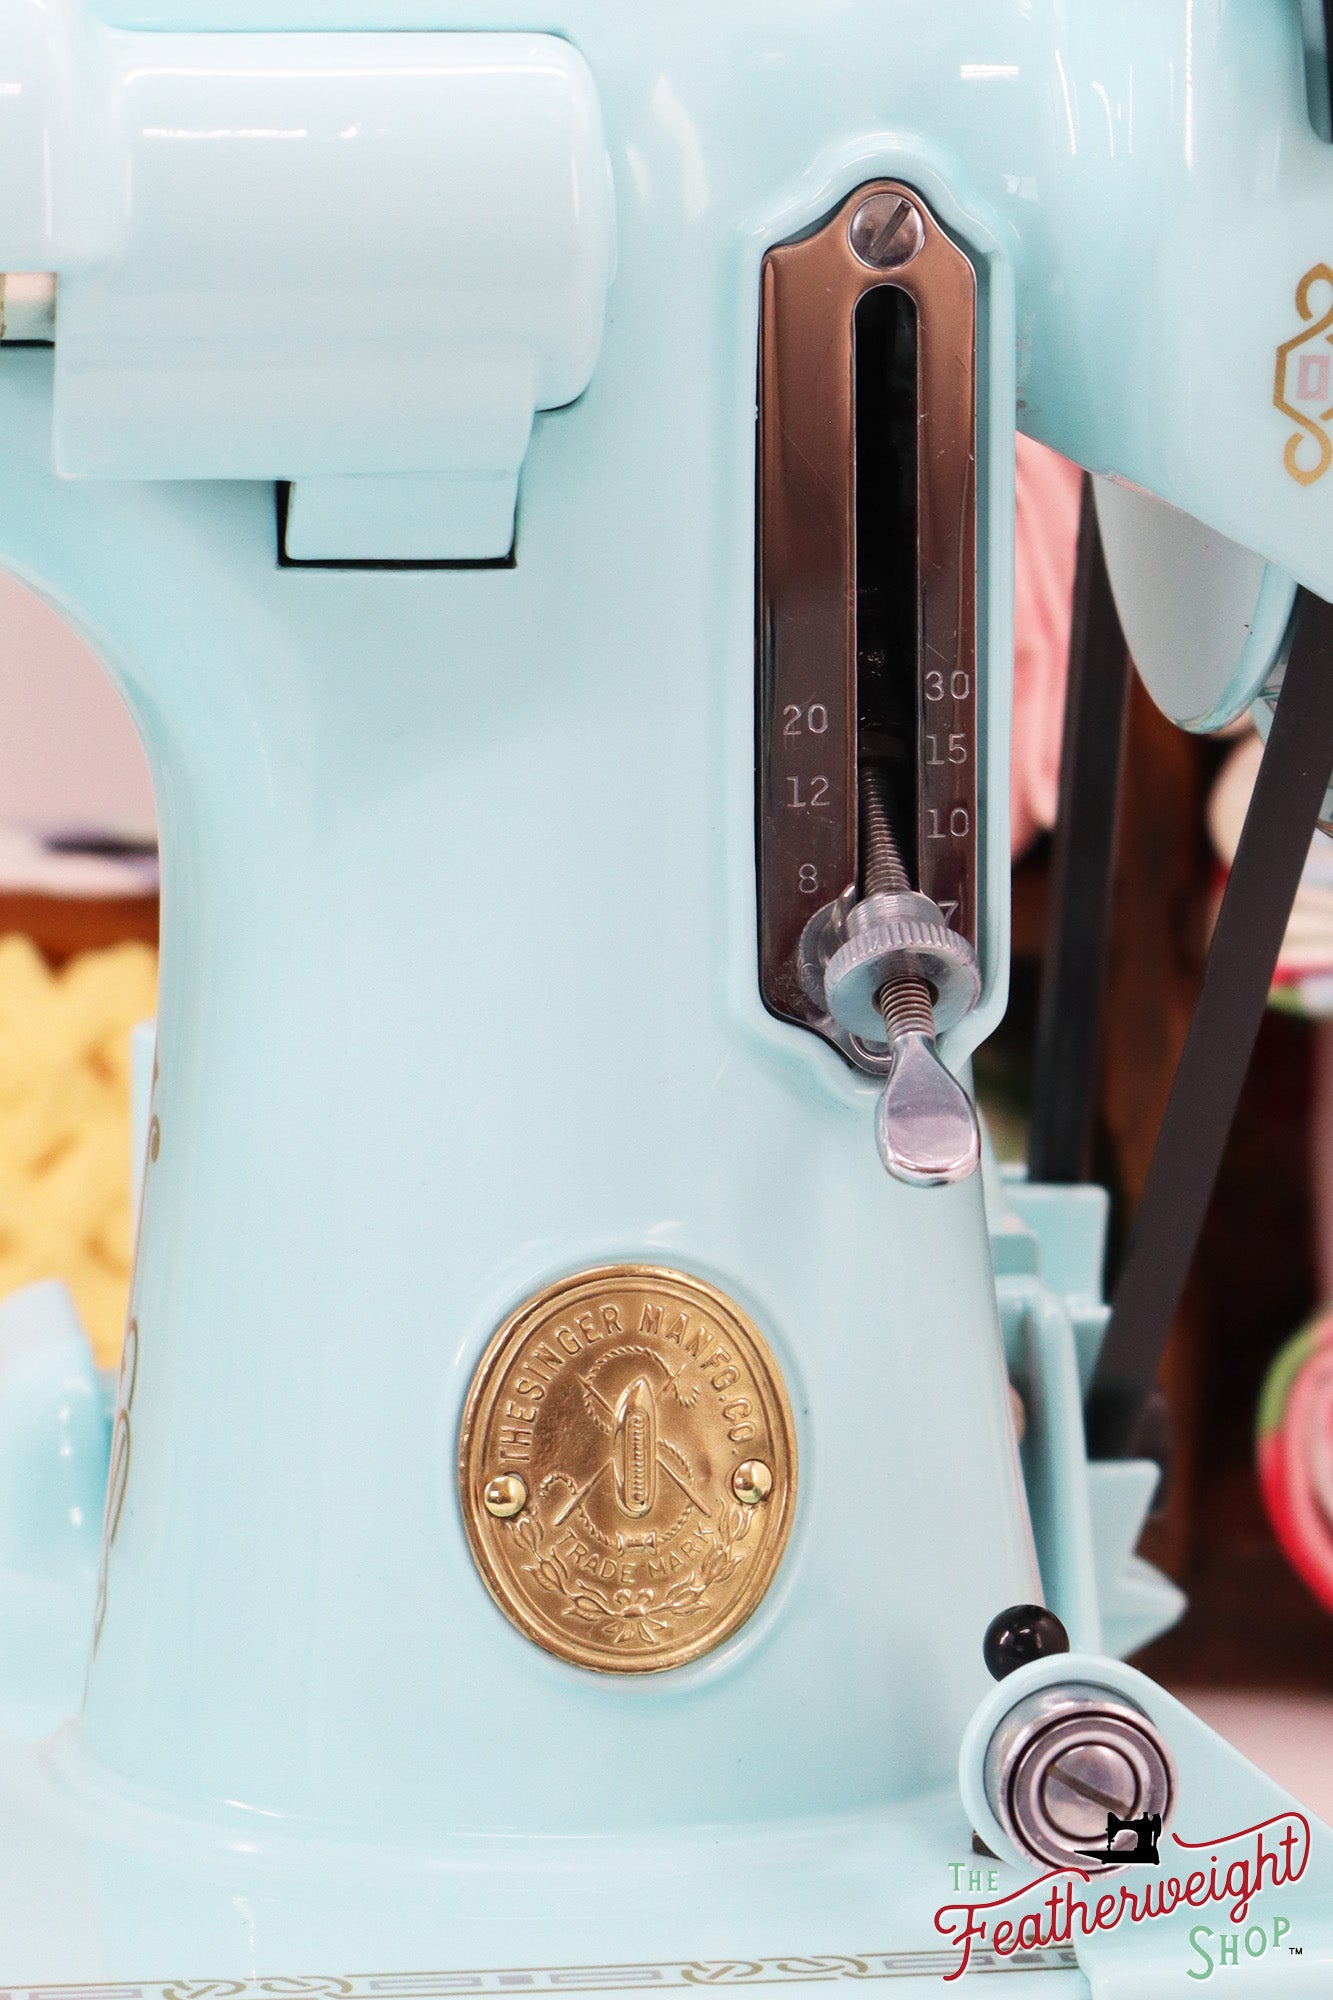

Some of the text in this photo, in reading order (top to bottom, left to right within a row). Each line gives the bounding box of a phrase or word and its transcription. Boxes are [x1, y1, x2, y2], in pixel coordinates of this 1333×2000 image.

[925, 670, 970, 701] 30
[783, 703, 829, 736] 20
[925, 733, 968, 765] 15
[786, 775, 831, 808] 12
[926, 807, 970, 839] 10
[798, 863, 819, 894] 8
[937, 899, 959, 927] 7
[515, 1303, 624, 1401] SINGER
[499, 1400, 540, 1464] THE
[555, 1521, 715, 1584] TRADE MARK
